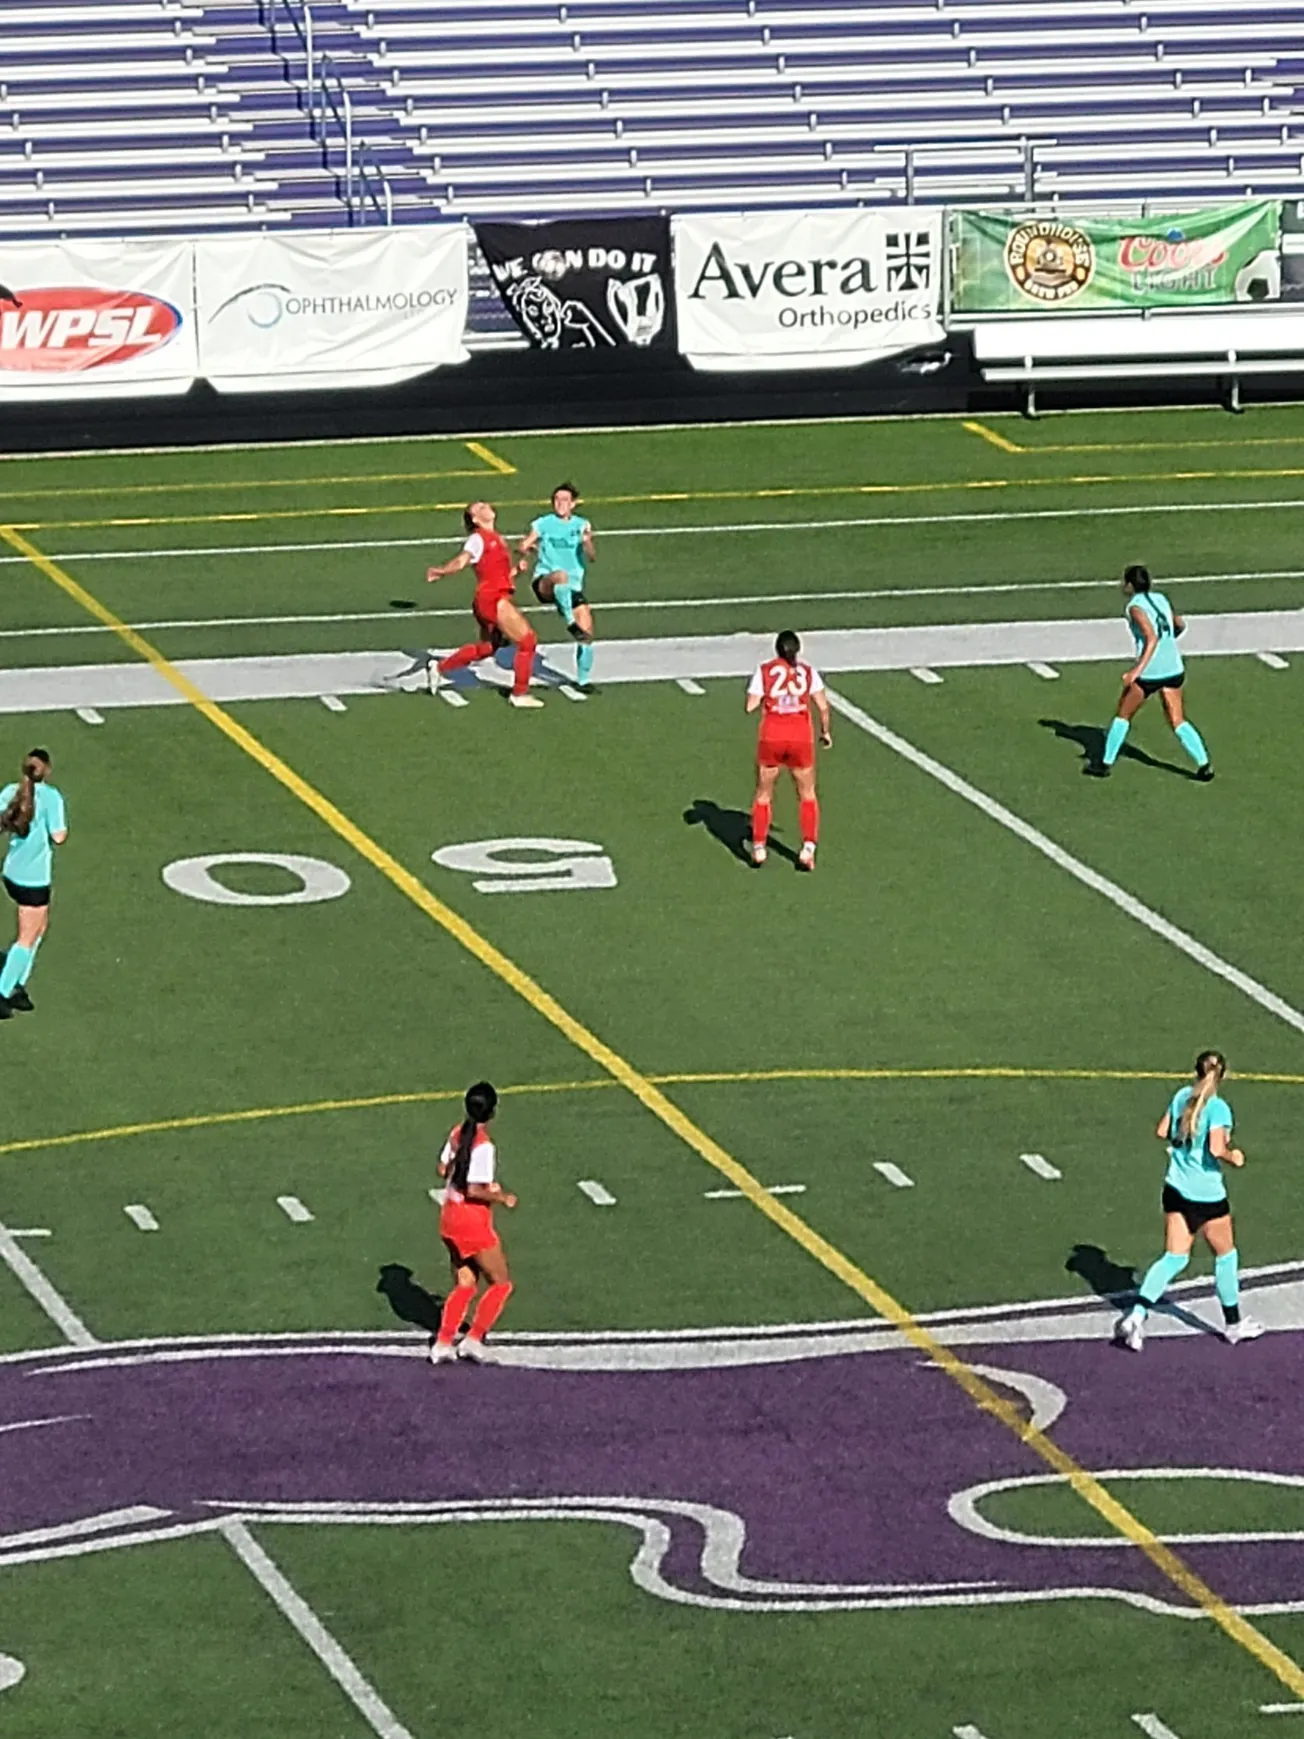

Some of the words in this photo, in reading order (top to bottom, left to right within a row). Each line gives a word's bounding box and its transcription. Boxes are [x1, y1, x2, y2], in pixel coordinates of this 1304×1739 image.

[492, 257, 528, 281] WE
[532, 249, 583, 278] CN
[588, 248, 626, 269] DO
[631, 252, 657, 273] IT
[688, 241, 878, 299] Avera
[286, 288, 458, 315] OPHTHALMOLOGY
[778, 301, 932, 329] Orthopedics
[0, 305, 162, 349] WPSL
[769, 665, 808, 698] 23
